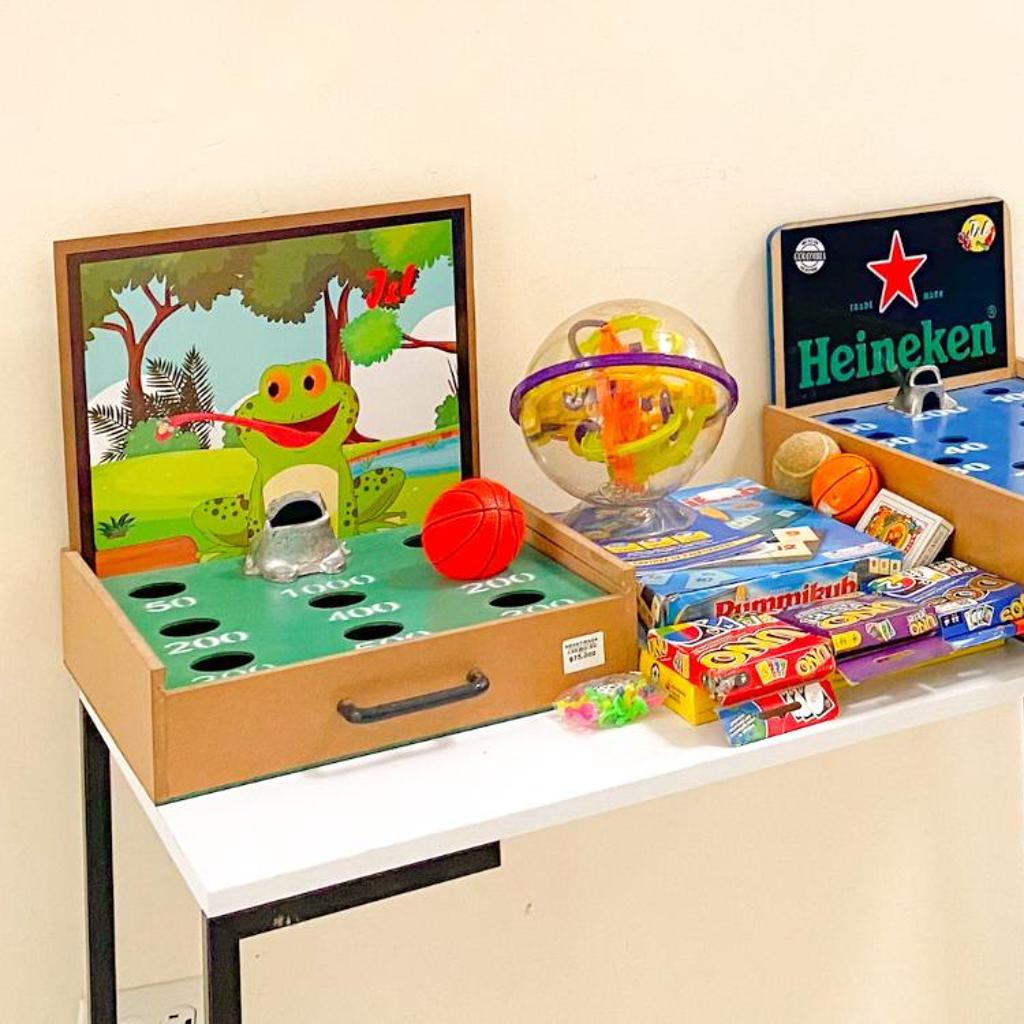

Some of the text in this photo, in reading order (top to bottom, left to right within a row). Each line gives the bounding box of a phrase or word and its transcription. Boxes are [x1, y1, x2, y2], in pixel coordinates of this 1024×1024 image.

[797, 318, 996, 389] Heineken
[944, 442, 989, 455] 40
[281, 574, 376, 598] 1000
[458, 572, 536, 595] 200
[144, 596, 197, 613] 50
[713, 575, 859, 618] Rummikub
[328, 601, 401, 622] 400
[164, 631, 249, 655] 200
[699, 626, 807, 670] UNO
[795, 642, 832, 676] UNO
